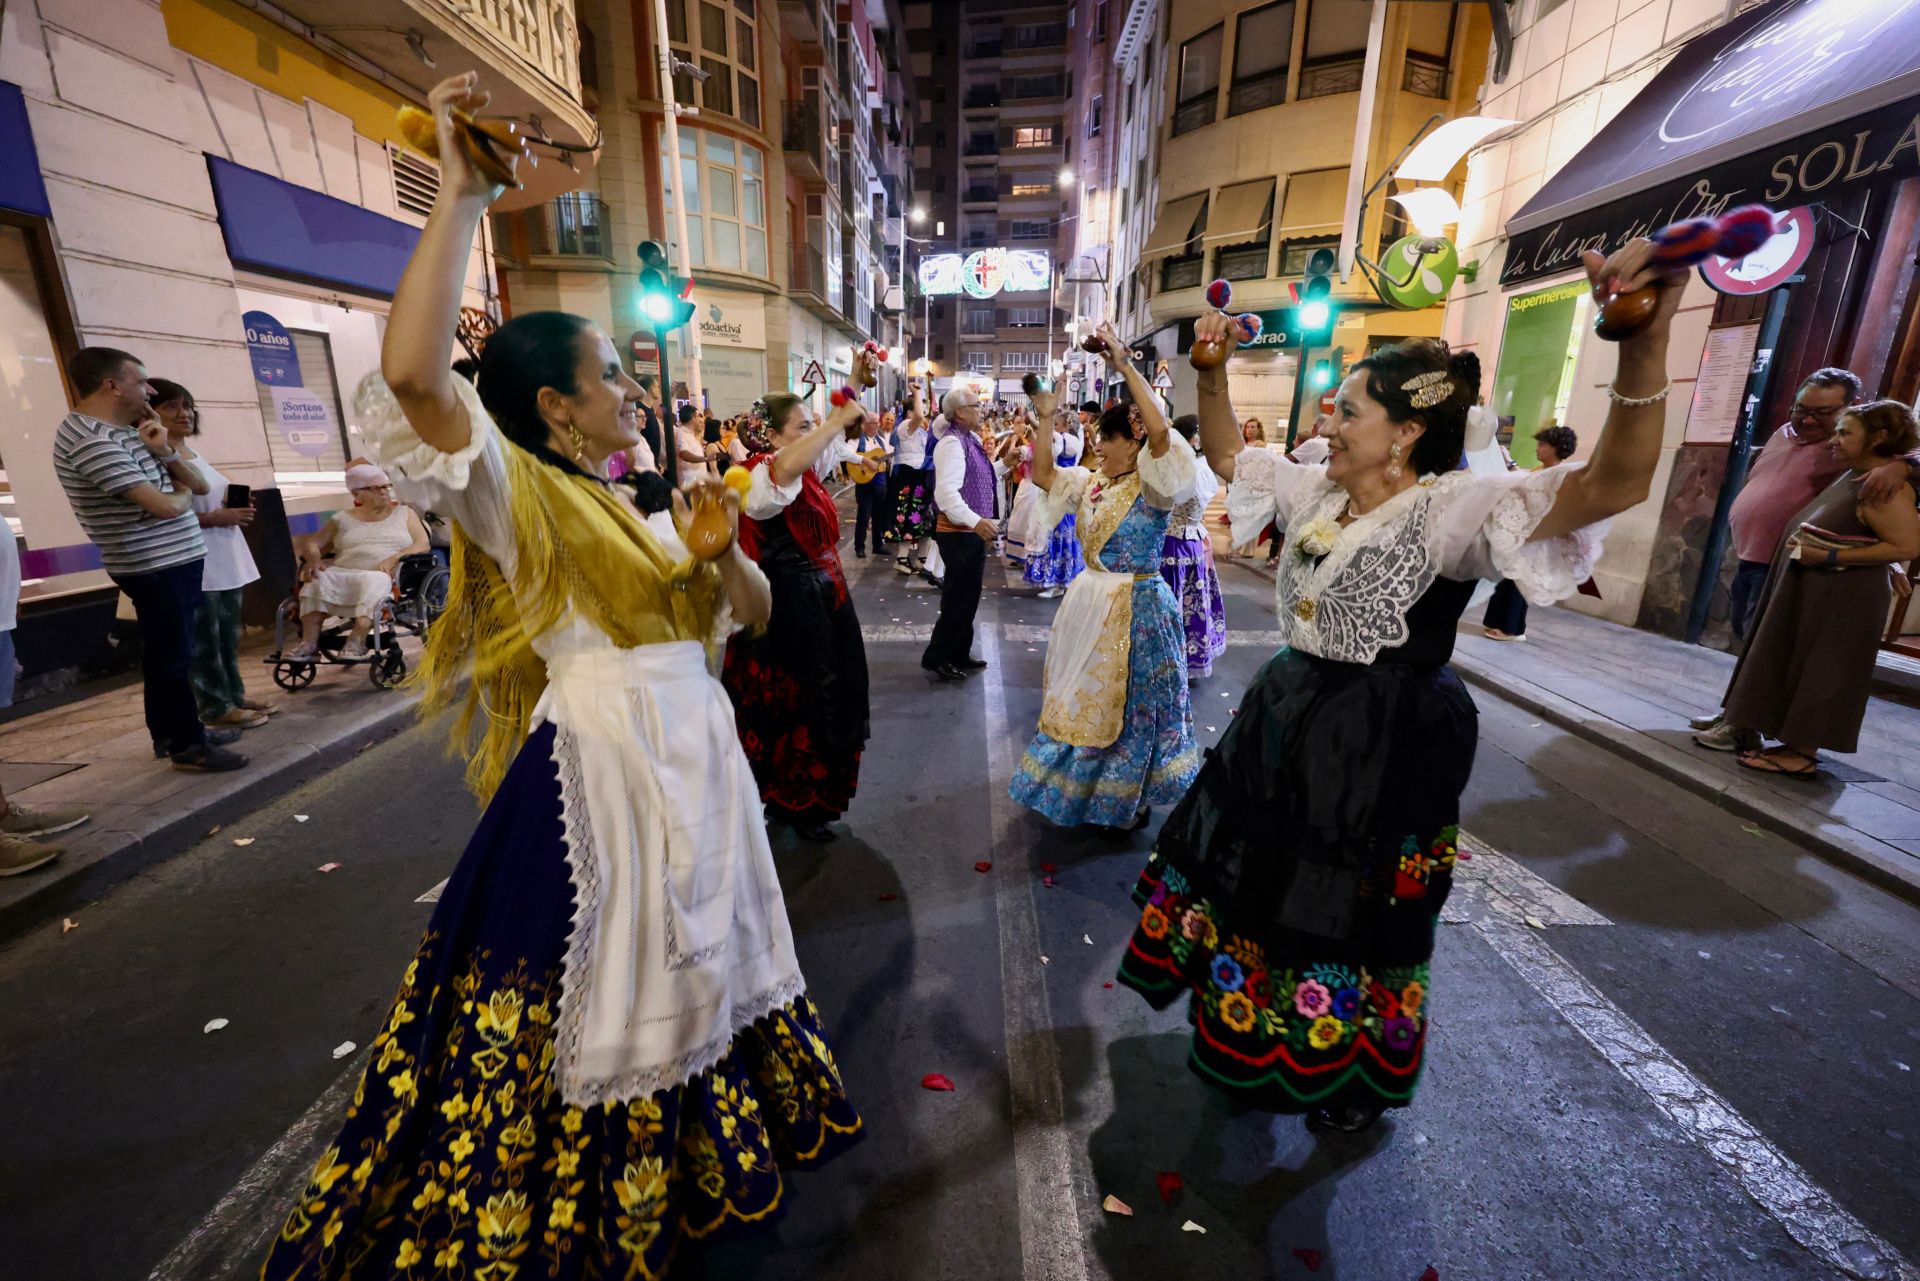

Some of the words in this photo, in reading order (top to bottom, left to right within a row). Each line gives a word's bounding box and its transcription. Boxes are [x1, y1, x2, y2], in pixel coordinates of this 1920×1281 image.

[1504, 248, 1528, 278] La
[1533, 221, 1610, 271] Cueva
[1616, 208, 1663, 247] del
[1510, 282, 1590, 313] Supermercado
[259, 330, 290, 346] años
[282, 400, 323, 412] ¡Sorteos
[282, 412, 302, 421] todo
[302, 412, 309, 421] el
